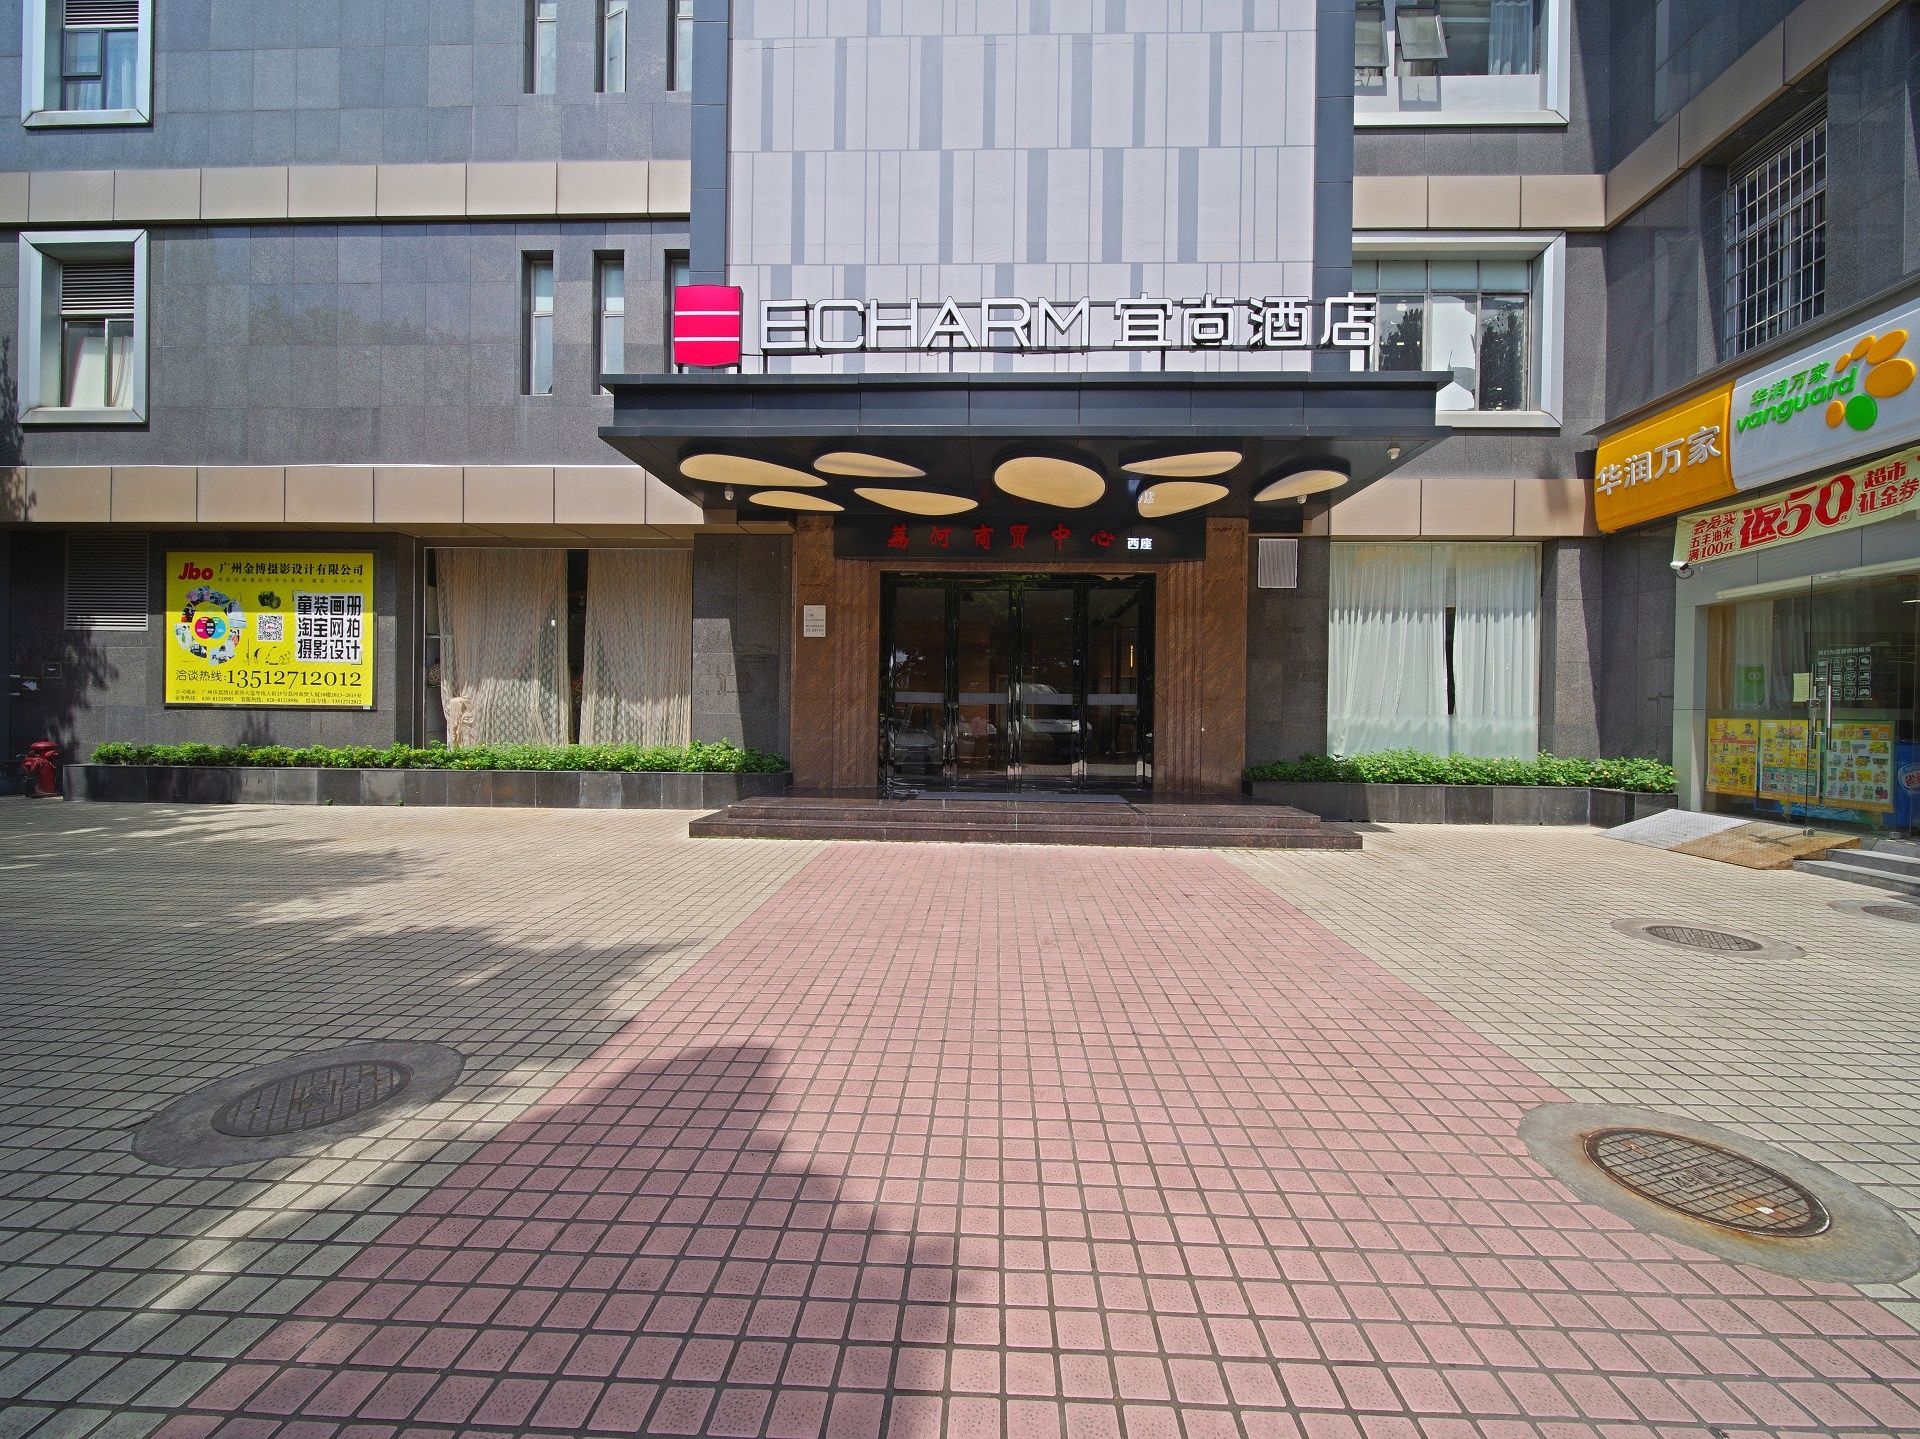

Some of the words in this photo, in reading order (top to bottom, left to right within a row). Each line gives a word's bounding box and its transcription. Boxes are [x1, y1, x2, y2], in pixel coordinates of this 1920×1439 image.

[760, 296, 1090, 349] ECHARM
[1113, 292, 1377, 348] 宜尚酒店
[1750, 359, 1832, 408] 华润万家
[1736, 366, 1859, 433] vanguard
[1596, 425, 1722, 496] 华润万家
[1864, 461, 1907, 490] 超市
[1858, 478, 1919, 514] 礼金券
[887, 523, 1116, 552] 荔河商贸中心
[1127, 537, 1153, 551] 西座
[1693, 511, 1737, 535] 会员买
[1688, 542, 1734, 562] 满100元
[178, 562, 214, 580] Jbo
[219, 563, 364, 577] 广州金博摄影设计有限公司
[297, 595, 362, 617] 童装画册
[297, 618, 361, 639] 淘宝网拍
[297, 639, 361, 660] 摄影设计
